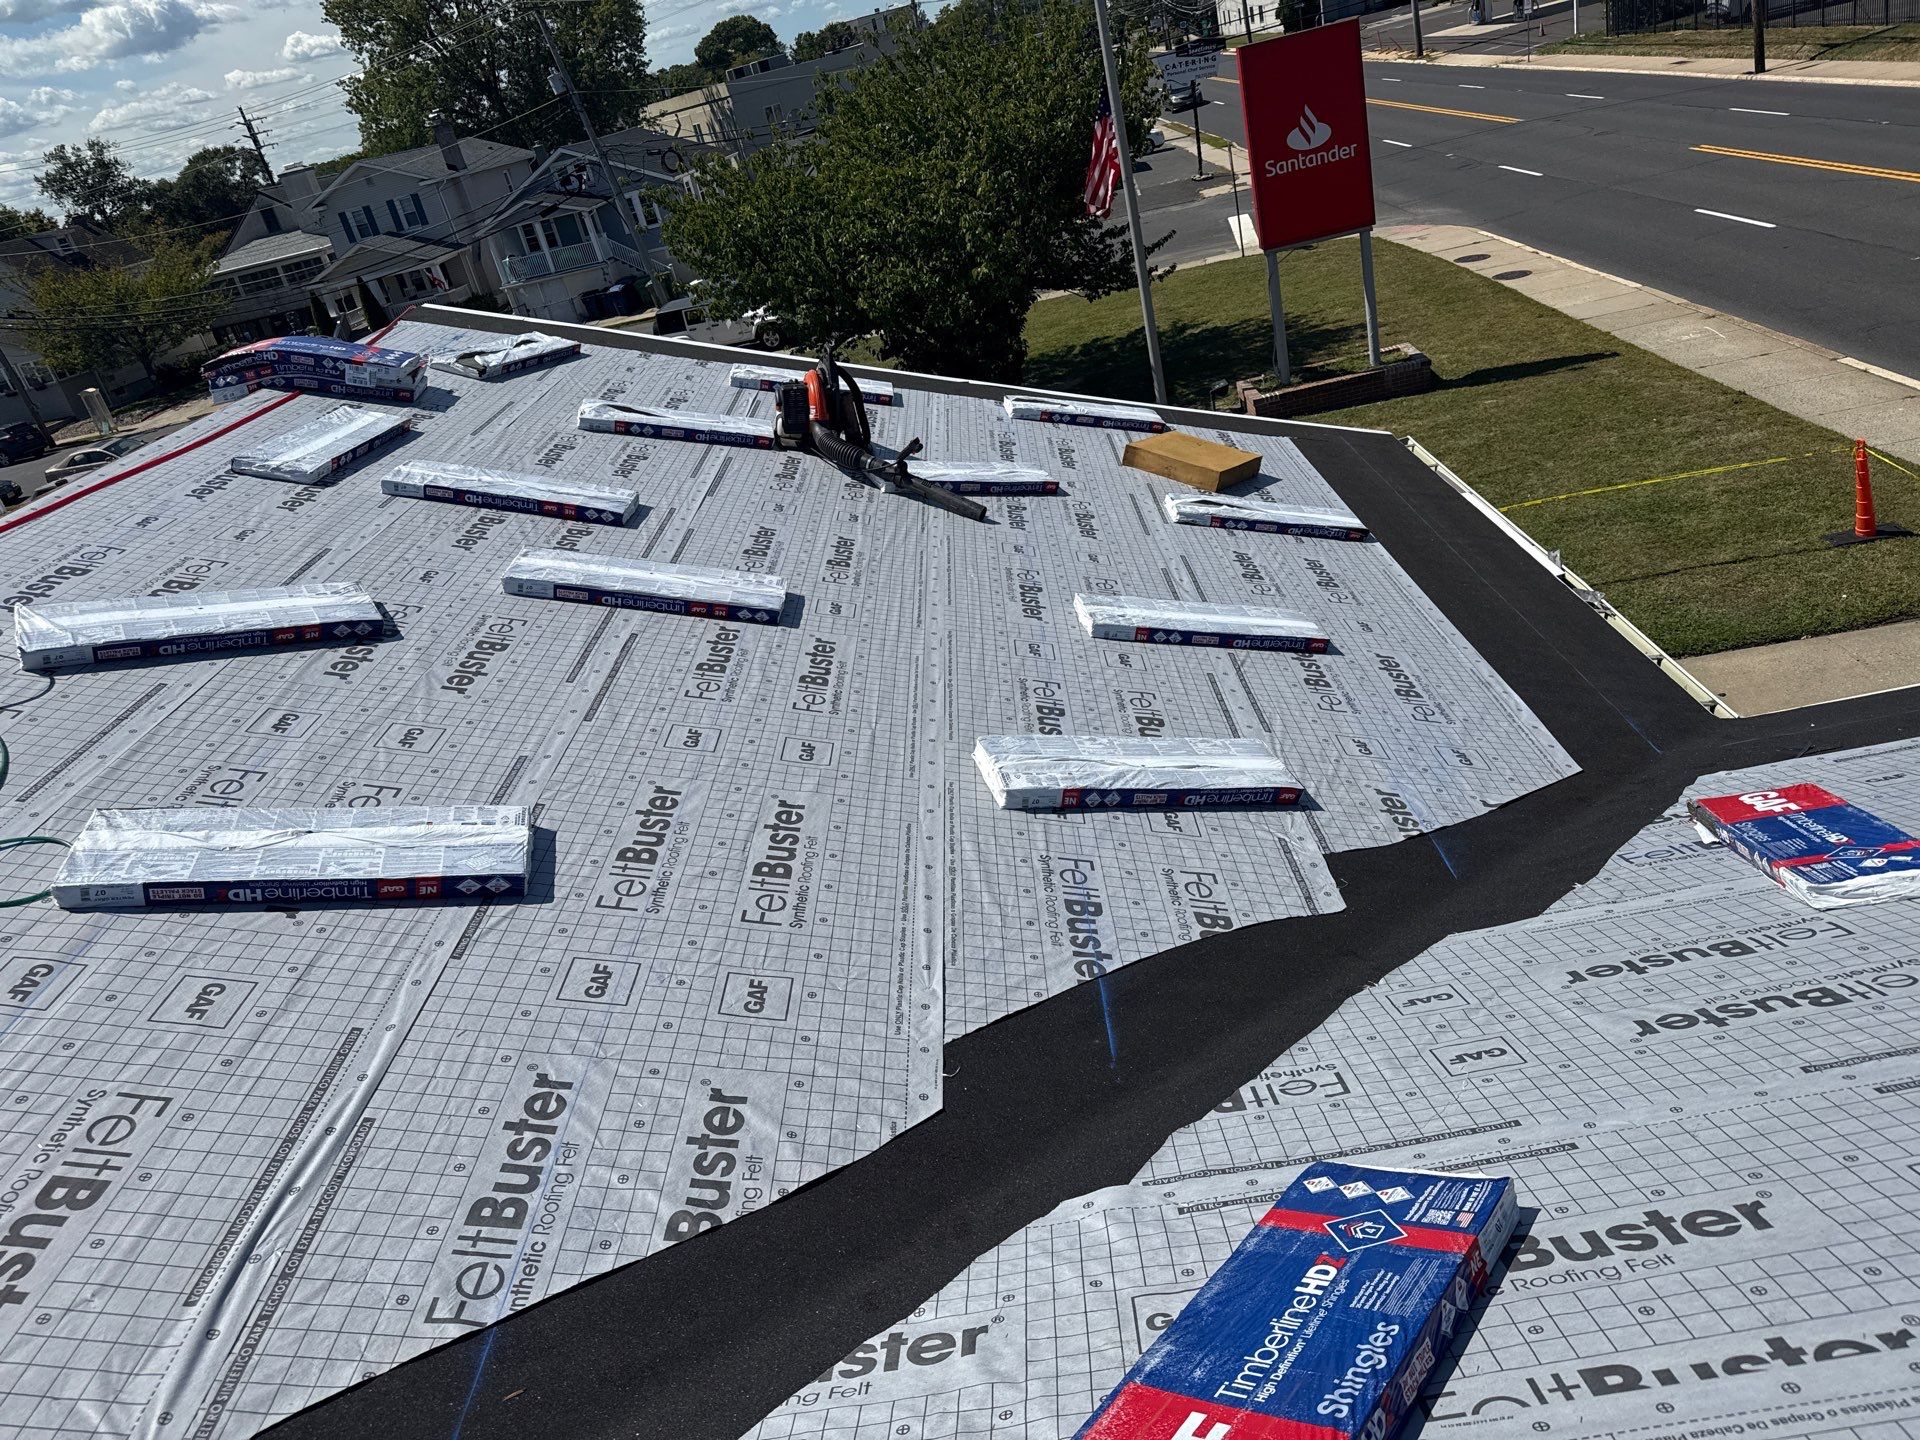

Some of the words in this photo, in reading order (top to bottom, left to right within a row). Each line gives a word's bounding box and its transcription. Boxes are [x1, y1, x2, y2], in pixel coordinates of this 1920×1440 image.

[1264, 143, 1357, 178] Santander
[736, 526, 776, 573] FeltBuster
[822, 536, 855, 585] FeltBuster
[1232, 550, 1276, 597] FeltBuster
[1304, 558, 1352, 604] FeltBuster
[1017, 568, 1046, 621] FeltBuster
[440, 616, 528, 695] FeltBuster
[684, 626, 740, 700] FeltBuster
[1029, 643, 1041, 657] GAF
[1118, 653, 1132, 668] GAF
[792, 637, 836, 713] FeltBuster
[1374, 653, 1442, 724] FeltBuster
[1033, 680, 1066, 736] FeltBus
[272, 713, 299, 734] GAF
[398, 727, 424, 749] GAF
[683, 728, 703, 748] GAF
[799, 742, 816, 762] GAF
[1352, 738, 1372, 755] GAF
[1451, 749, 1474, 767] GAF
[175, 765, 221, 802] Synthetic
[325, 781, 356, 808] Synthe
[1738, 791, 1803, 812] GAF
[674, 820, 691, 836] Felt
[804, 836, 818, 849] Felt
[595, 785, 682, 912] FeltBuster
[665, 835, 688, 870] Roofing
[740, 799, 805, 926] FeltBuster
[799, 849, 819, 882] Roofing
[1040, 854, 1056, 891] Synthetic
[95, 889, 106, 897] 07
[380, 884, 404, 893] GAF
[419, 885, 437, 894] NE
[645, 870, 673, 914] Synthetic
[789, 883, 810, 929] Synthetic
[1048, 894, 1060, 928] Roofing
[1058, 856, 1114, 980] FeltBuste
[1162, 867, 1182, 910] Synthetic
[1175, 910, 1191, 941] Roofing
[1050, 928, 1062, 946] Felt
[1736, 915, 1823, 937] Synthetic
[1565, 921, 1856, 985] FeltBuster
[1628, 945, 1660, 956] Felt
[1664, 933, 1733, 949] Roofing
[6, 963, 55, 1003] GAF
[584, 964, 615, 999] GAF
[1824, 958, 1920, 981] Synthetic
[743, 979, 770, 1014] GAF
[1402, 992, 1453, 1007] GAF
[1702, 993, 1737, 1004] Felt
[1740, 976, 1822, 997] Roofing
[184, 983, 227, 1021] GAF
[1632, 971, 1920, 1037] eltBuster
[338, 1027, 360, 1056] FIELTRO
[893, 1025, 901, 1035] Use
[1449, 1048, 1508, 1065] GAF
[306, 1088, 323, 1110] PARA
[33, 1088, 107, 1163] Synthetic
[1475, 1120, 1514, 1132] FIELTRO
[275, 1140, 292, 1161] CON
[1389, 1138, 1415, 1148] PARA
[742, 1154, 763, 1181] Felt
[1147, 1168, 1222, 1185] INCORPORADA
[0, 1091, 174, 1308] FeltBust
[1183, 1201, 1223, 1213] FIELTRO
[246, 1316, 269, 1347] PARA
[262, 1273, 292, 1318] TECHOS,
[284, 1250, 304, 1275] CON
[334, 1118, 375, 1178] INCORPORADA
[510, 1241, 546, 1310] nthetic
[533, 1170, 573, 1236] Roofing
[556, 1140, 580, 1167] Felt
[185, 1231, 239, 1303] INCORPORADA
[1511, 1265, 1622, 1294] Roofing
[1625, 1254, 1676, 1274] Felt
[1214, 1252, 1347, 1401] TimberlineHDZ
[1255, 1378, 1278, 1405] High
[1321, 1274, 1350, 1311] Shingles
[1318, 1321, 1400, 1418] Shingles
[828, 1382, 873, 1400] Felt
[1788, 1408, 1824, 1424] Grapas
[1838, 1399, 1911, 1418] Plásticas
[1691, 1422, 1744, 1437] Cabeza
[1749, 1420, 1768, 1432] De
